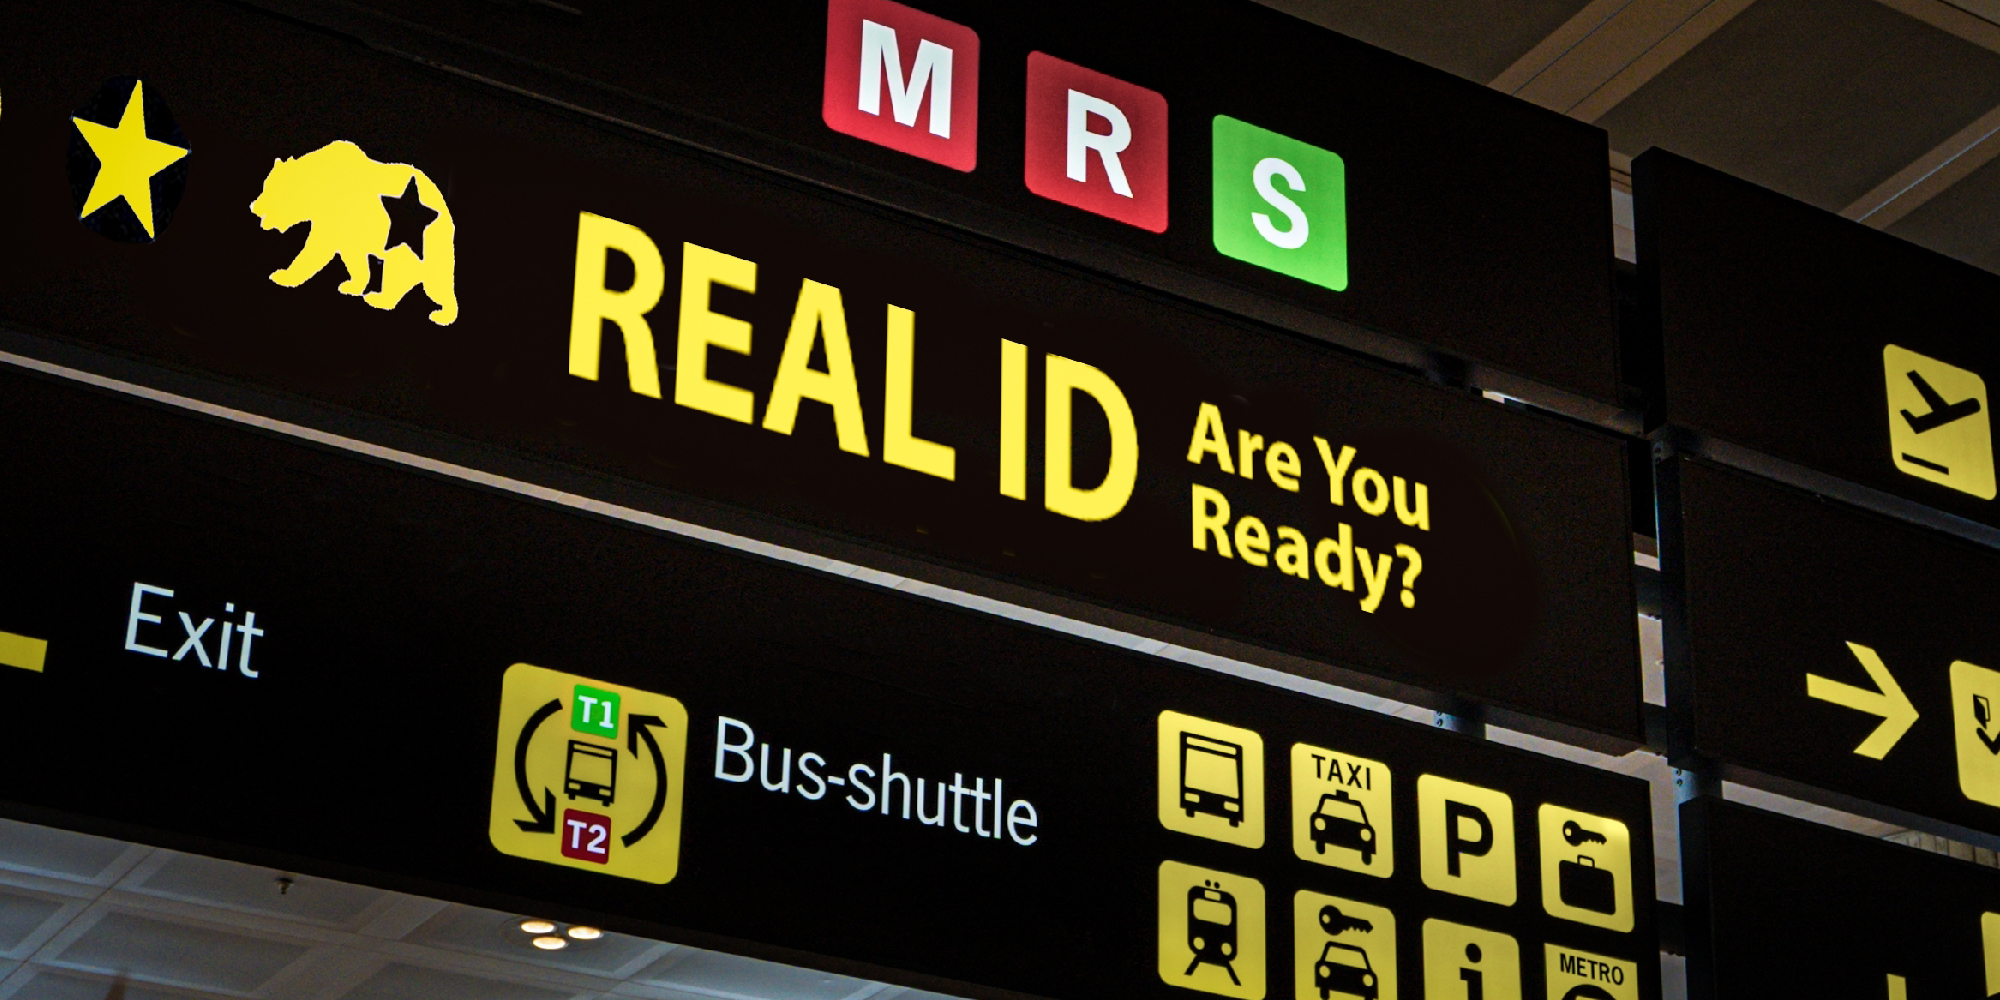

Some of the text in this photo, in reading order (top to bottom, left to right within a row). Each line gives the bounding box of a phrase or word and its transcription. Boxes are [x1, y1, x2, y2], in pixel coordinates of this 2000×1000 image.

[857, 19, 1310, 250] M R S
[568, 211, 1139, 522] REAL ID
[1187, 402, 1430, 531] Are You
[1190, 483, 1423, 614] Ready?
[124, 582, 265, 679] Exit
[578, 695, 614, 730] T1
[715, 715, 1038, 846] Bus-shuttle
[1311, 753, 1372, 792] TAXI
[567, 819, 607, 855] T2
[1444, 799, 1494, 878] P
[1559, 953, 1625, 986] METRO
